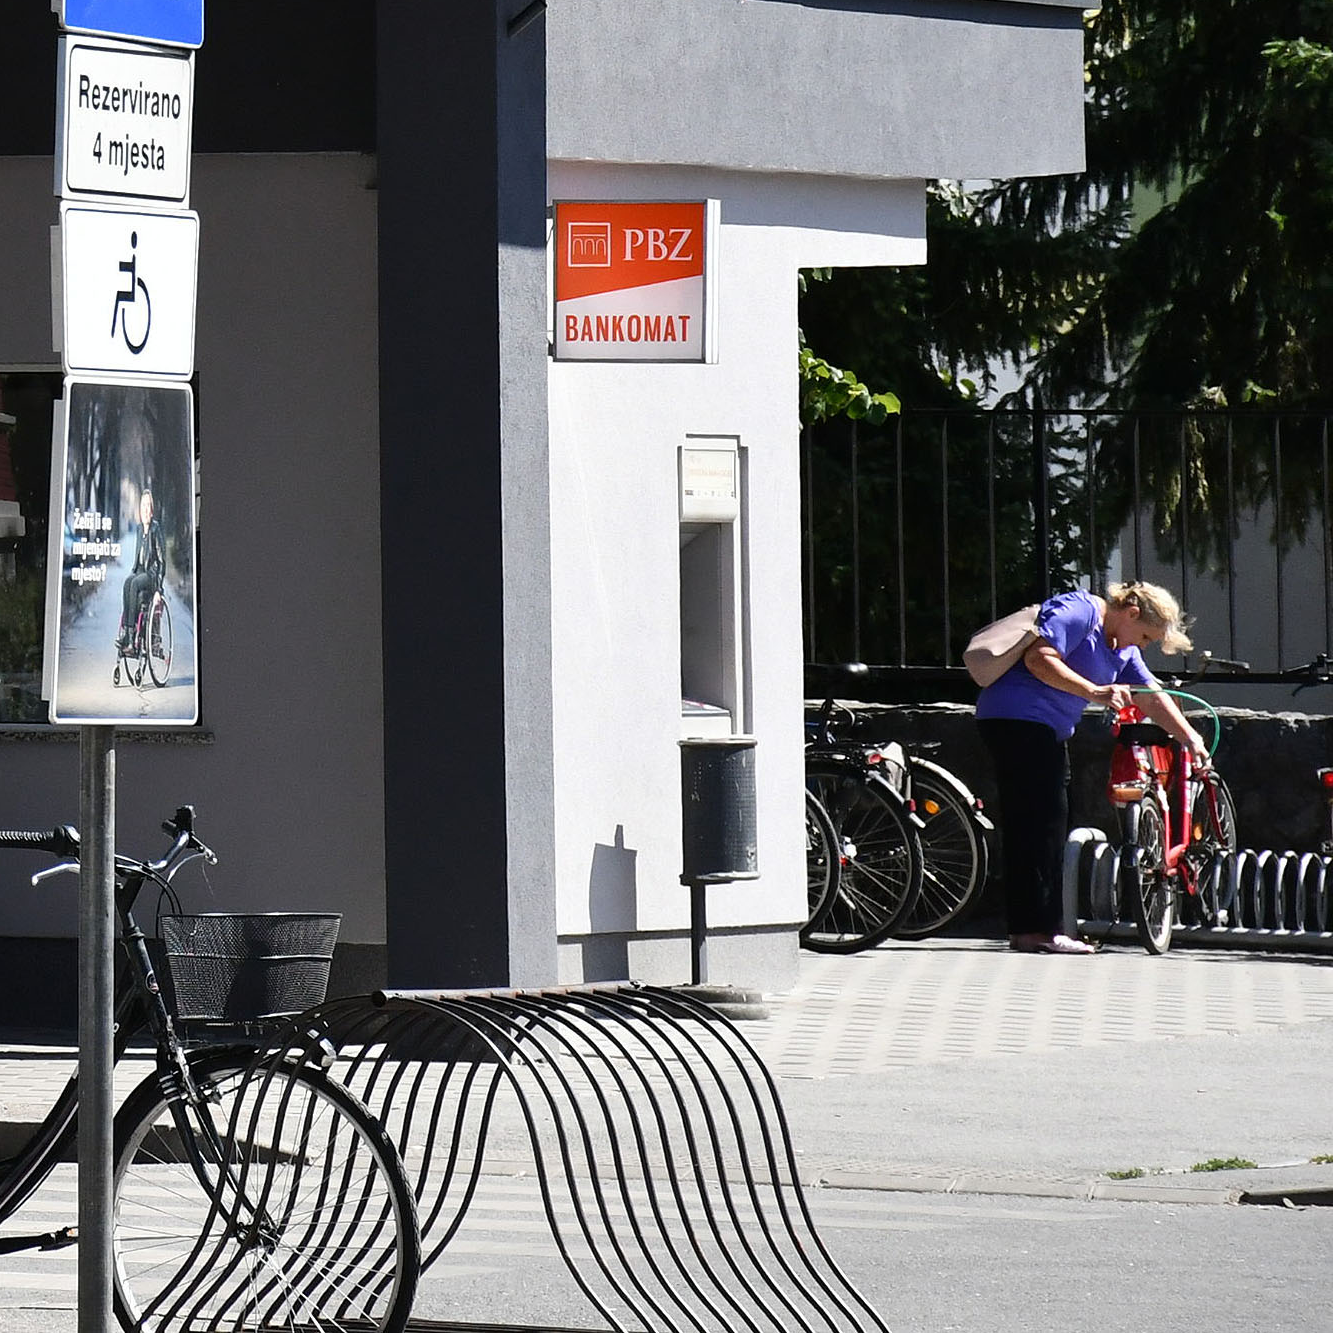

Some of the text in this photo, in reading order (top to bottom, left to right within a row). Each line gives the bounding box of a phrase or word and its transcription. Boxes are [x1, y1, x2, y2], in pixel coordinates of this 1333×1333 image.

[78, 74, 182, 120] Rezervirano
[92, 131, 165, 174] 4 mjesta
[622, 228, 693, 262] PBZ
[565, 314, 691, 343] BANKOMAT
[102, 517, 112, 531] se
[73, 537, 121, 560] mijenjati za
[72, 562, 107, 586] mjesto?
